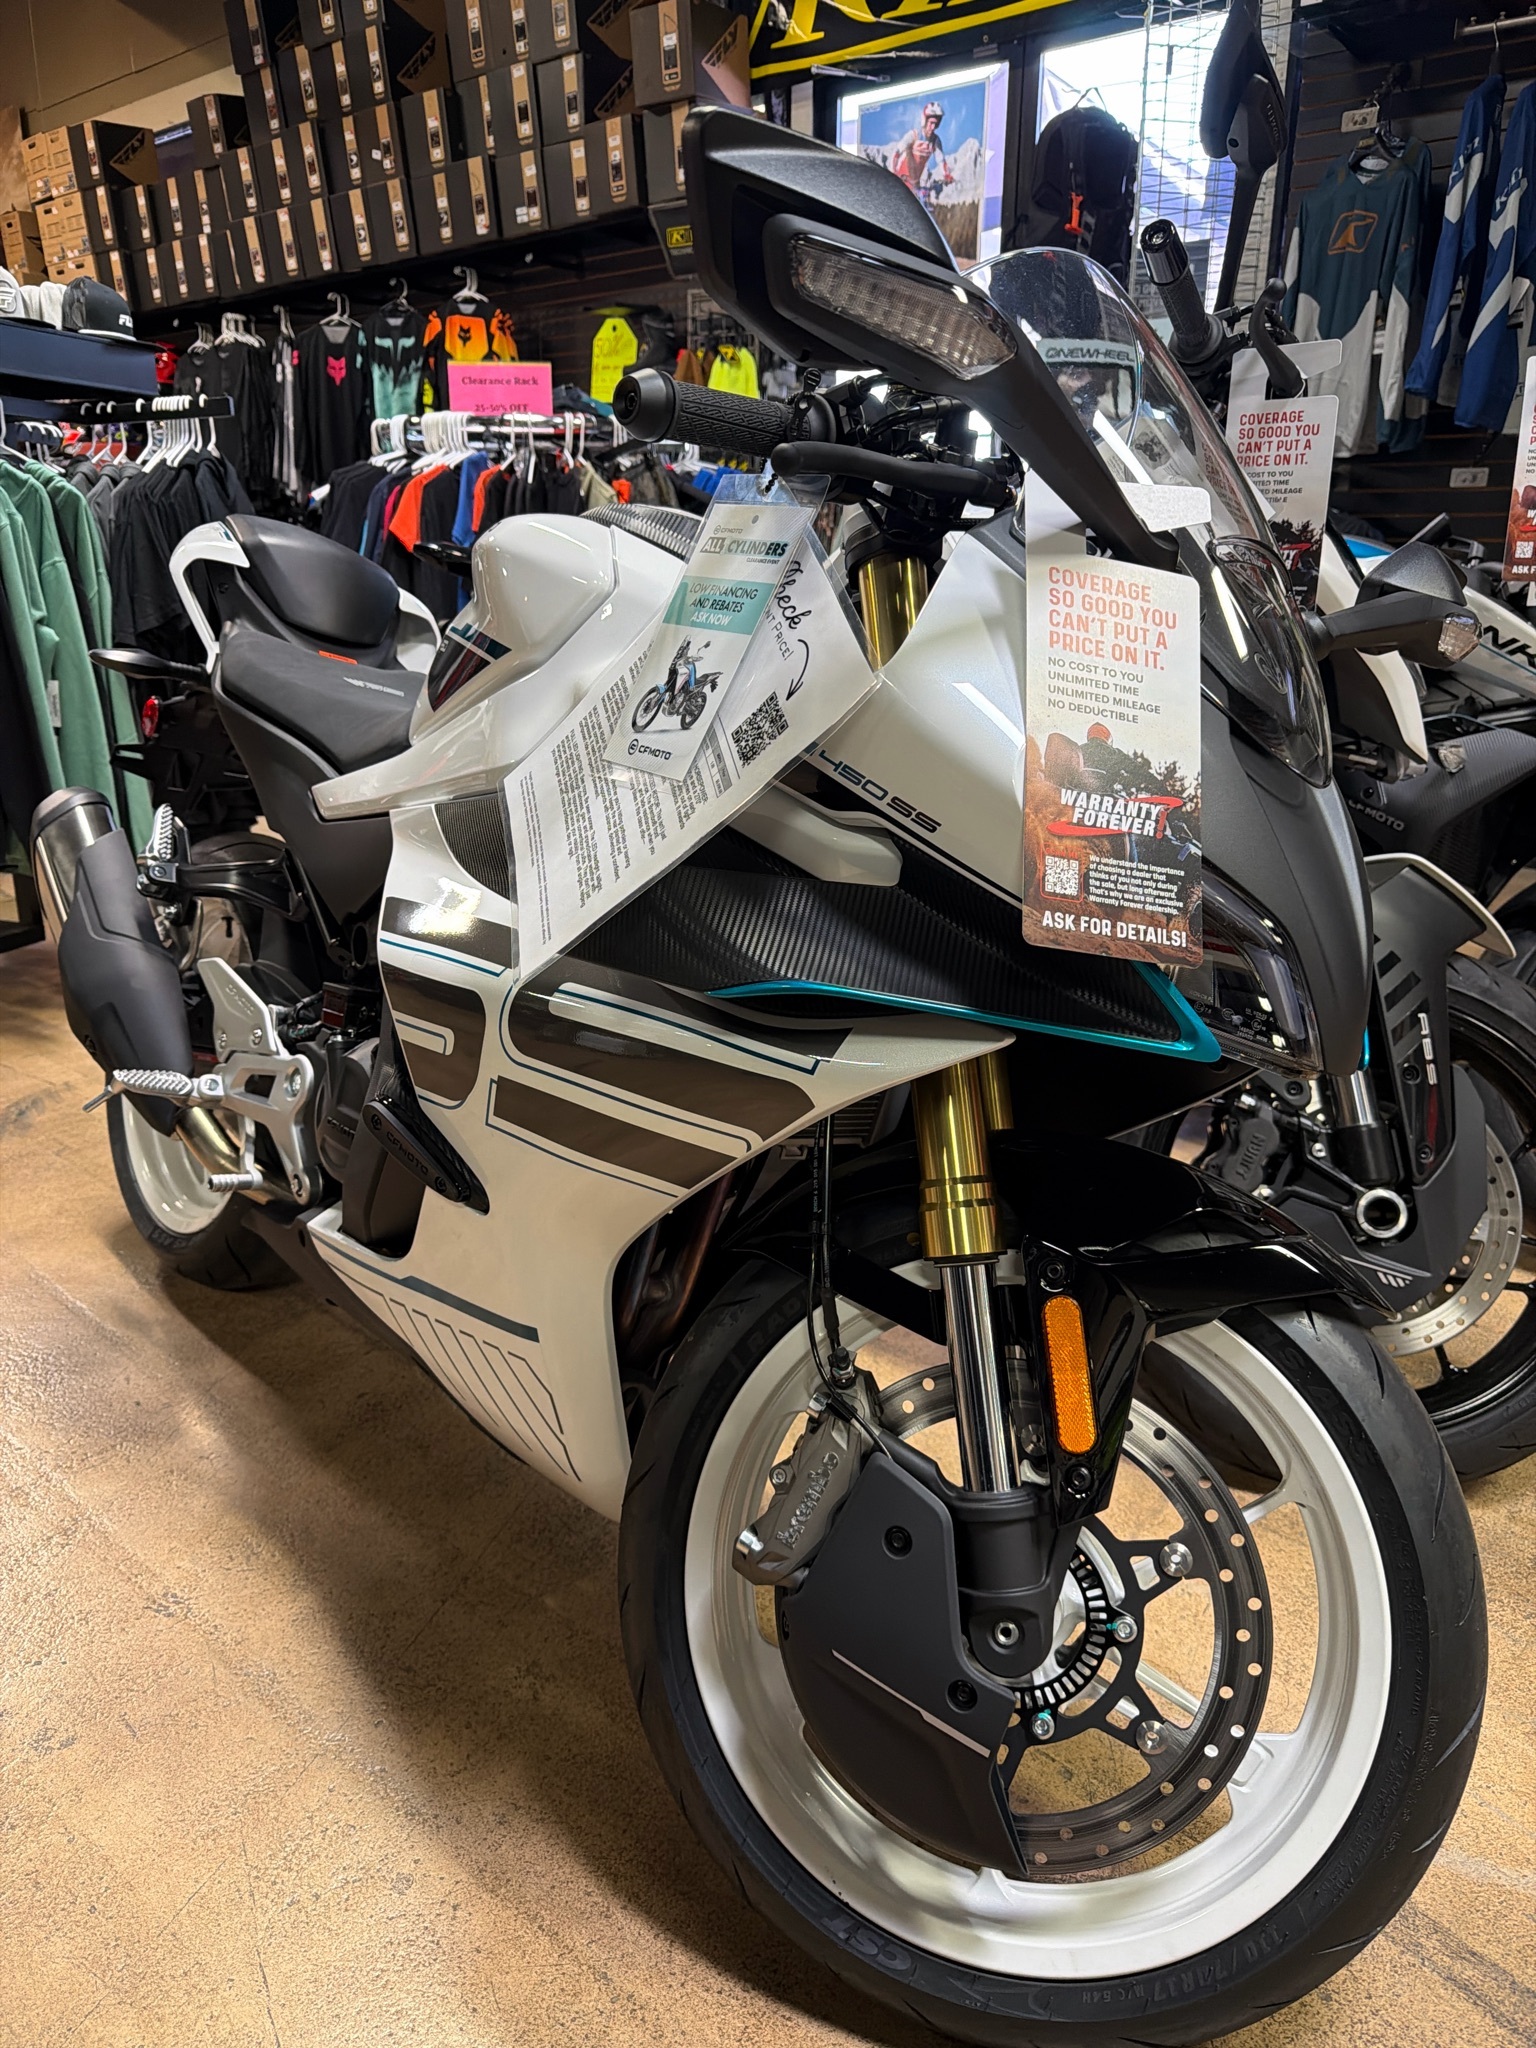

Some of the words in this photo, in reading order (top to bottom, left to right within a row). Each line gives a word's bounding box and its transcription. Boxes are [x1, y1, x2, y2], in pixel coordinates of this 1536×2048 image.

[461, 376, 511, 386] Clearance
[514, 376, 539, 386] Rack
[509, 403, 529, 413] OFF
[1240, 410, 1305, 426] COVERAGE
[1238, 427, 1254, 440] SO
[1258, 425, 1292, 439] GOOD
[1295, 423, 1320, 437] YOU
[1237, 440, 1274, 454] CAN'T
[1276, 439, 1300, 453] PUT
[1304, 438, 1312, 451] A
[1237, 454, 1270, 468] PRICE
[1273, 453, 1291, 466] ON
[1295, 453, 1308, 465] IT.
[1277, 470, 1294, 478] YOU
[727, 540, 788, 557] CYLINDERS
[689, 583, 709, 594] LOW
[709, 585, 759, 600] FINANCING
[1049, 566, 1152, 603] COVERAGE
[689, 597, 709, 609] AND
[709, 598, 745, 613] REBATES
[1049, 587, 1075, 608] SO
[1081, 594, 1134, 621] GOOD
[1139, 605, 1177, 630] YOU
[690, 611, 709, 622] ASK
[707, 614, 733, 626] NOW
[1049, 609, 1107, 637] CAN'T
[1113, 621, 1150, 646] PUT
[1155, 631, 1168, 650] A
[1049, 630, 1105, 659] PRICE
[1111, 643, 1137, 665] ON
[1144, 649, 1165, 671] IT.
[1048, 656, 1066, 668] NO
[1068, 660, 1100, 675] COST
[1102, 666, 1117, 678] TO
[1119, 670, 1144, 684] YOU
[1048, 670, 1110, 690] UNLIMITED
[1112, 682, 1140, 697] TIME
[1047, 697, 1066, 710] NO
[1068, 702, 1139, 724] DEDUCTIBLE
[1048, 684, 1110, 704] UNLIMITED
[1112, 696, 1161, 715] MILEAGE
[638, 745, 673, 760] CFMOTO
[1060, 788, 1163, 821] WARRANTY
[1072, 807, 1167, 840] FOREVER!
[1089, 854, 1100, 862] We
[1100, 857, 1137, 869] understand
[1137, 862, 1149, 871] the
[1149, 864, 1185, 877] importance
[1097, 864, 1126, 876] choosing
[1131, 869, 1153, 879] dealer
[1152, 873, 1167, 882] that
[1089, 870, 1109, 880] thinks
[1109, 873, 1118, 881] of
[1118, 875, 1130, 884] you
[1130, 877, 1142, 885] not
[1142, 879, 1157, 889] only
[1157, 881, 1178, 893] during
[1089, 878, 1100, 886] the
[1116, 882, 1128, 891] but
[1129, 884, 1143, 895] long
[1143, 887, 1177, 899] afterward.
[1088, 894, 1120, 907] Warranty
[1120, 899, 1144, 909] Forever
[1144, 903, 1179, 916] dealership.
[1109, 889, 1123, 899] why
[1123, 892, 1133, 900] we
[1133, 894, 1145, 902] are
[1155, 897, 1184, 908] exclusive
[1042, 910, 1076, 931] ASK
[1079, 916, 1112, 937] FOR
[1116, 921, 1187, 948] DETAILS!
[1417, 1012, 1439, 1086] ABS
[386, 1130, 430, 1177] CFMOTO
